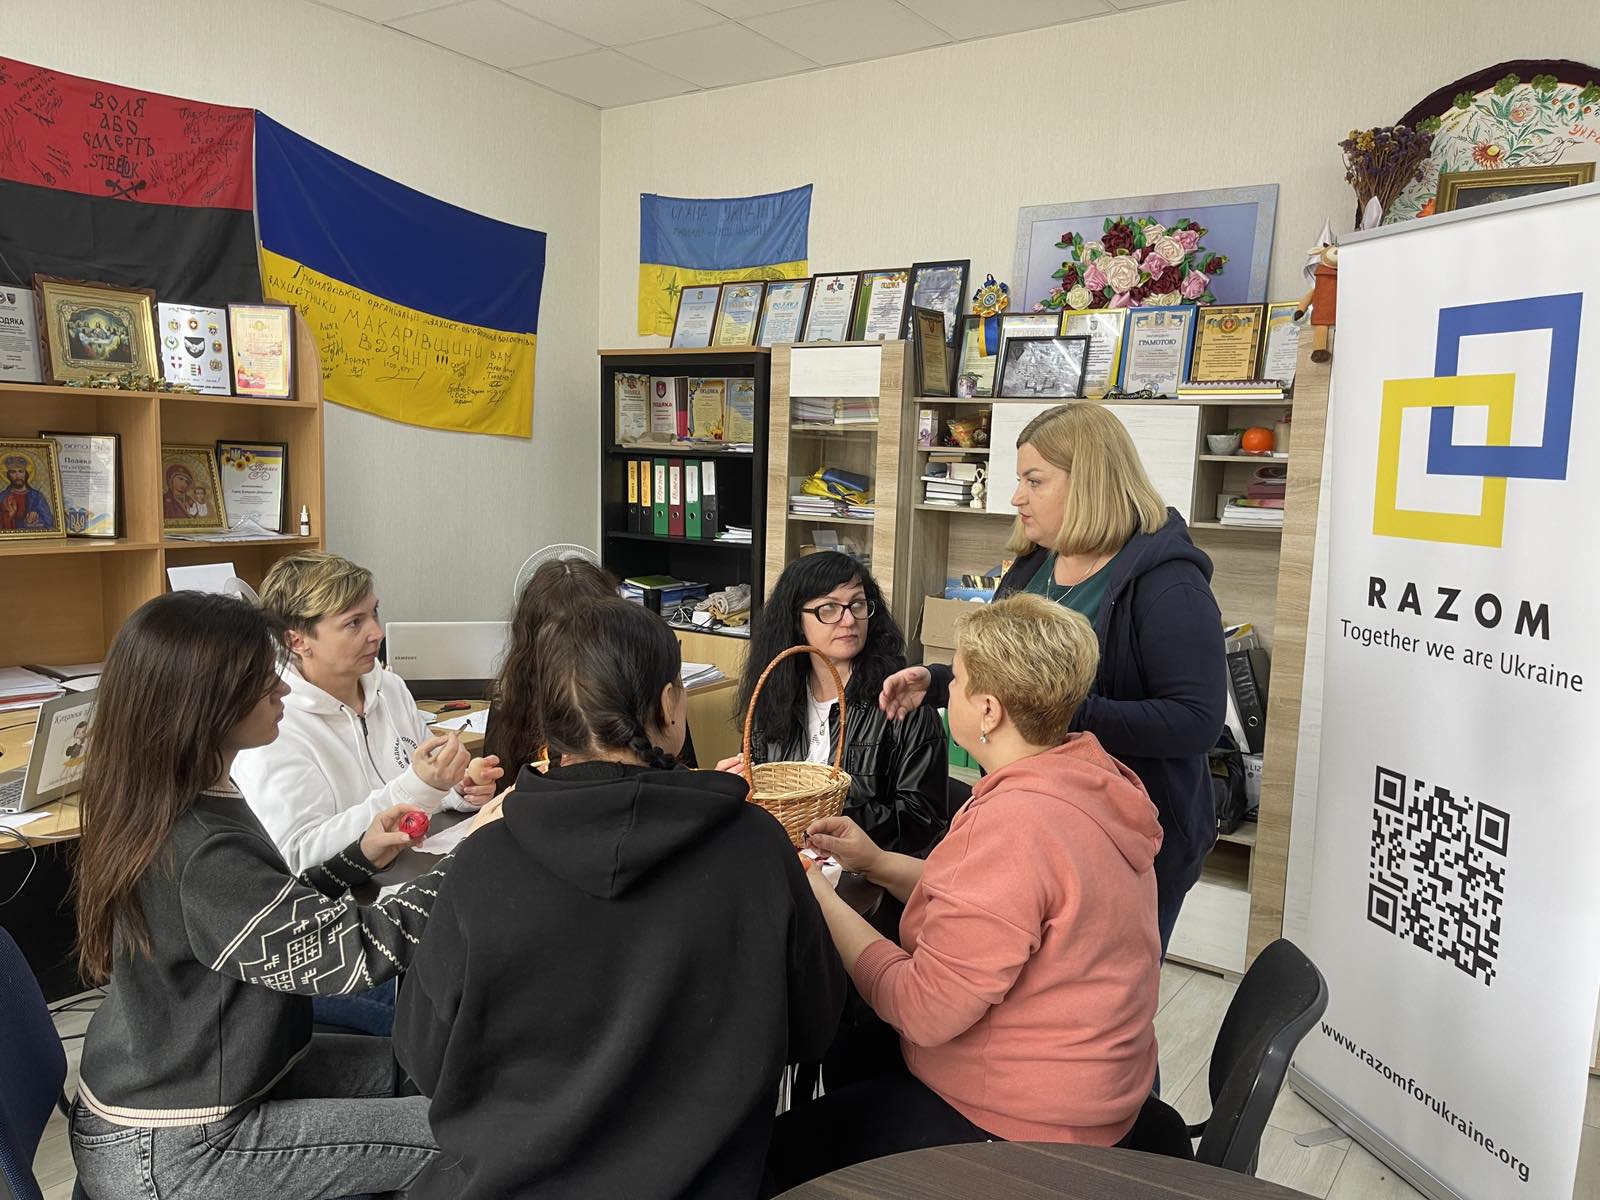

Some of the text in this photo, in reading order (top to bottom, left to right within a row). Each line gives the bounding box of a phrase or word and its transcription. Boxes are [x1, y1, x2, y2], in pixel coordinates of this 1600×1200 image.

[89, 91, 147, 117] ВОЛЯ
[100, 112, 138, 136] АБО
[83, 131, 155, 157] СМЕРТЬ
[343, 308, 483, 360] МАКАРІВЩИНИ
[358, 332, 429, 367] ВДЯЧНІ
[1138, 338, 1177, 347] ГРАМОТОЮ
[1367, 575, 1550, 641] RAZOM
[1340, 618, 1583, 692] Together we are Ukraine
[1321, 1020, 1530, 1183] www.razomforukraine.org
